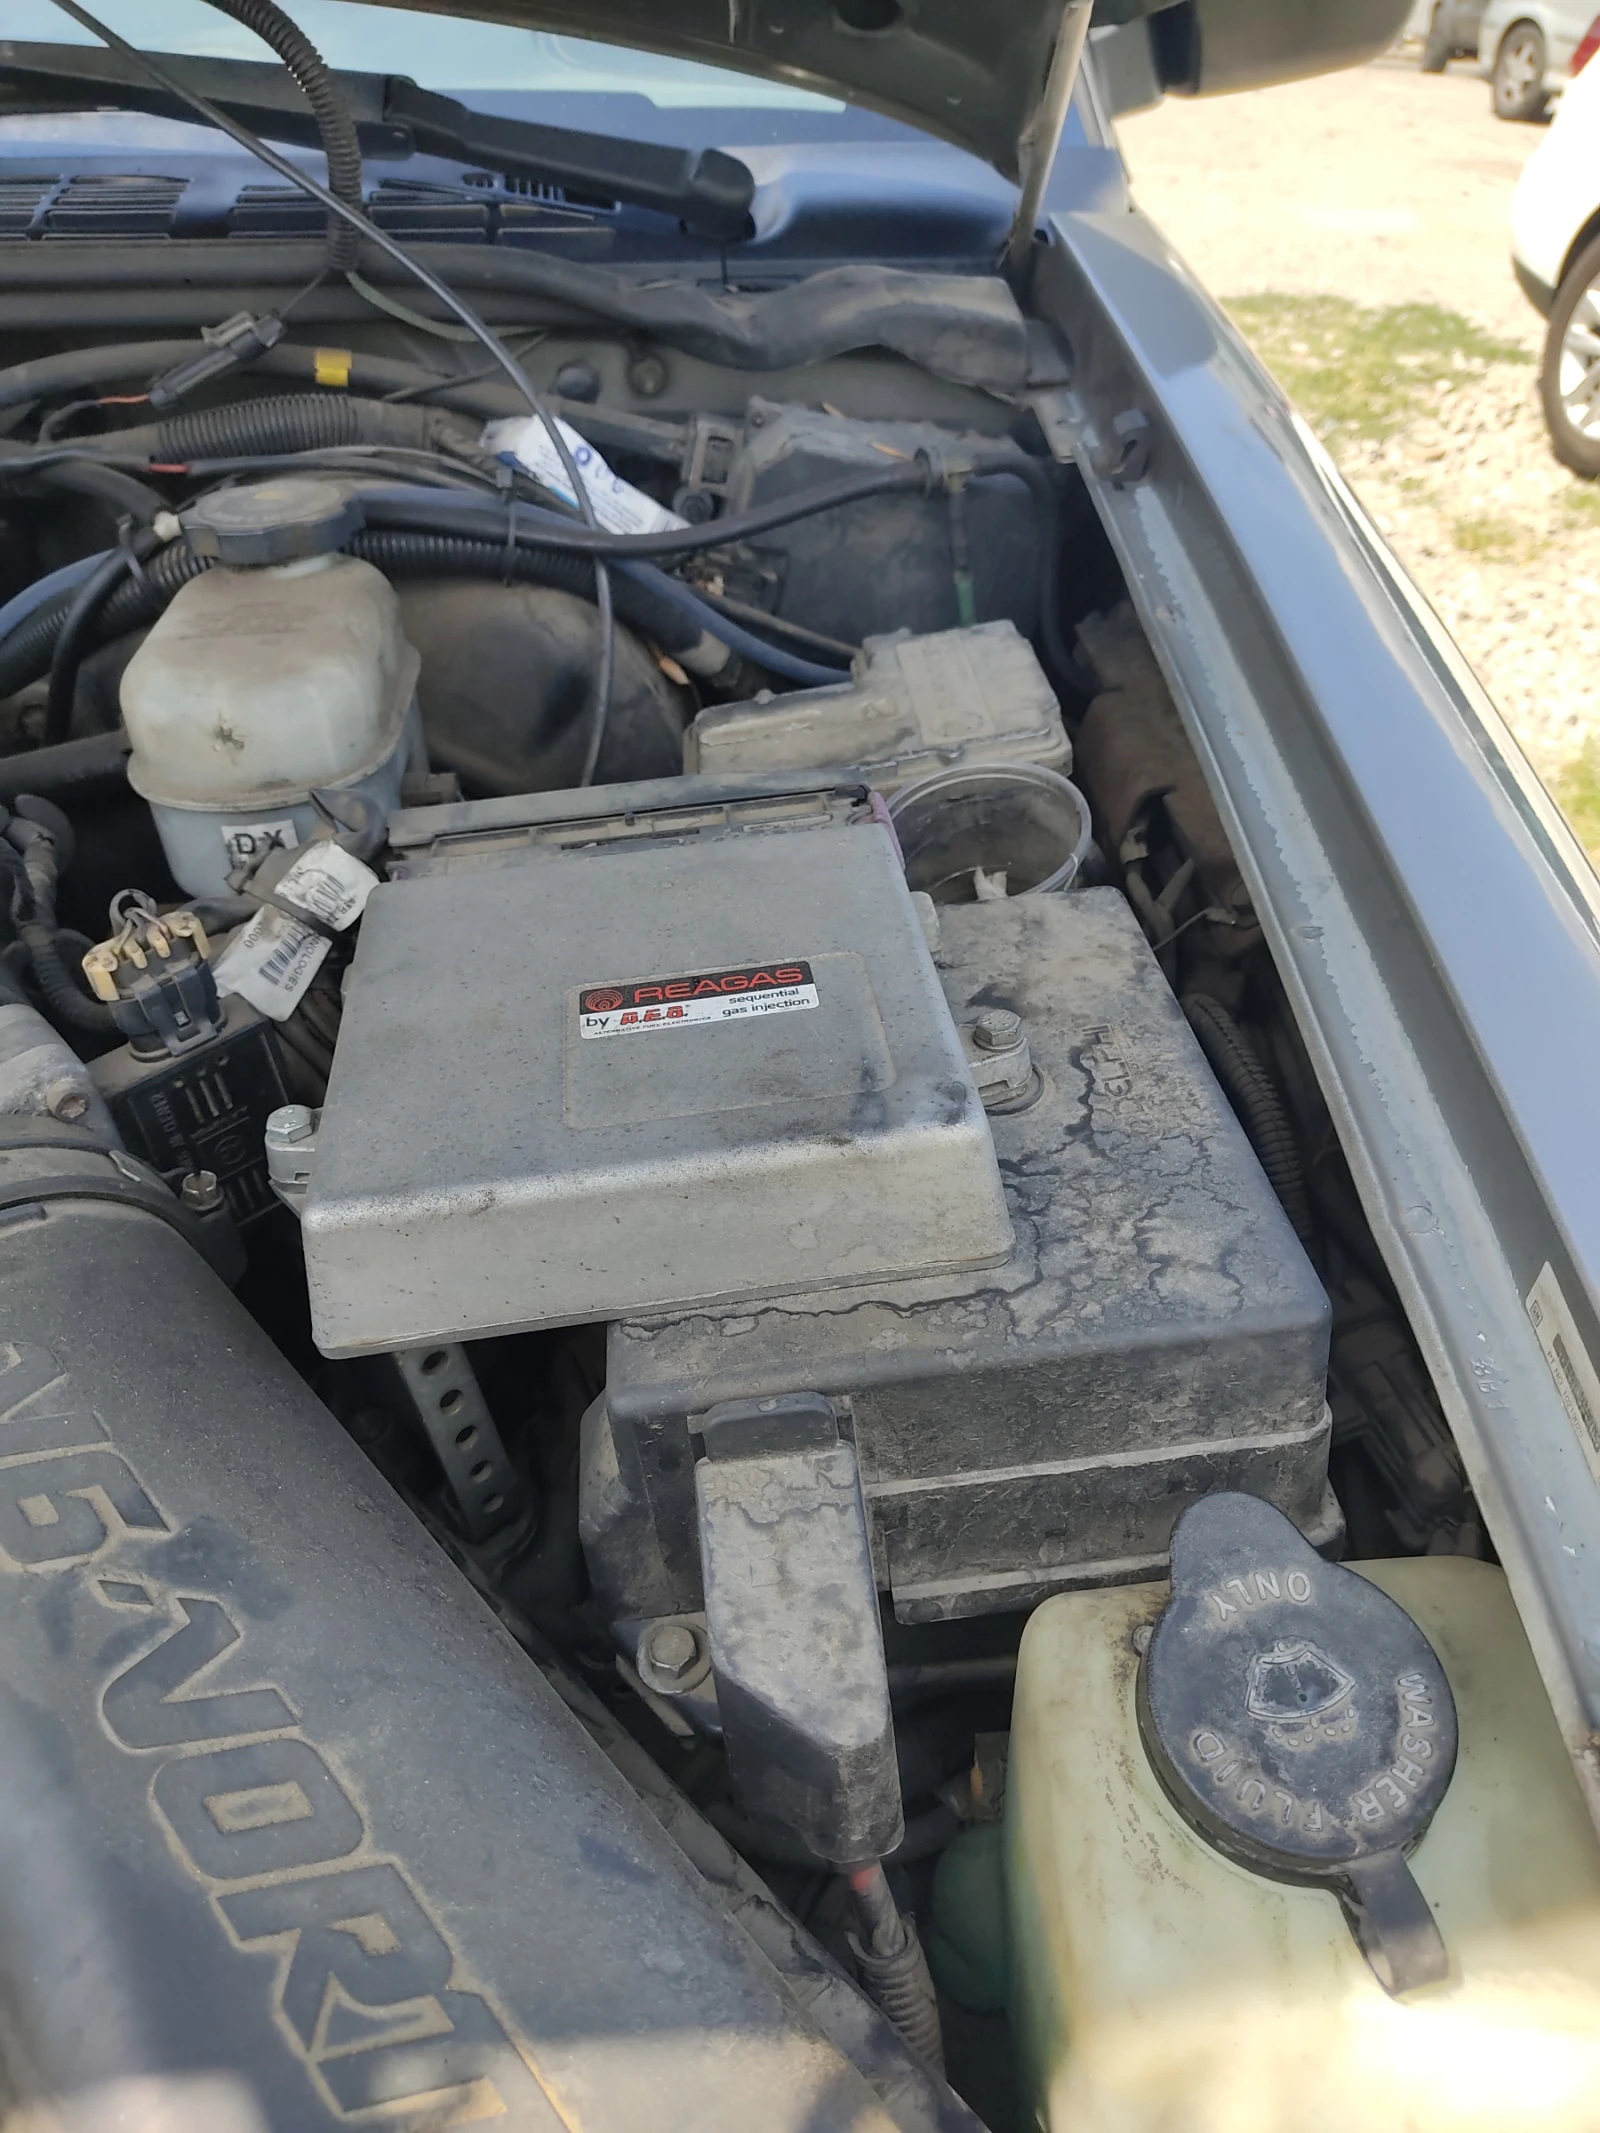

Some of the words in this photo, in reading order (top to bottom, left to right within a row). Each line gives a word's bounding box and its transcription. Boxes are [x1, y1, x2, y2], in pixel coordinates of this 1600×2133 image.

[633, 967, 804, 1004] REAGAS
[728, 987, 800, 1005] sequential
[585, 1015, 611, 1029] by
[722, 1007, 748, 1018] gas
[751, 996, 810, 1014] injection
[1210, 1570, 1312, 1621] ONLY
[1353, 1672, 1434, 1822] WASHER
[1193, 1732, 1324, 1833] FLUID
